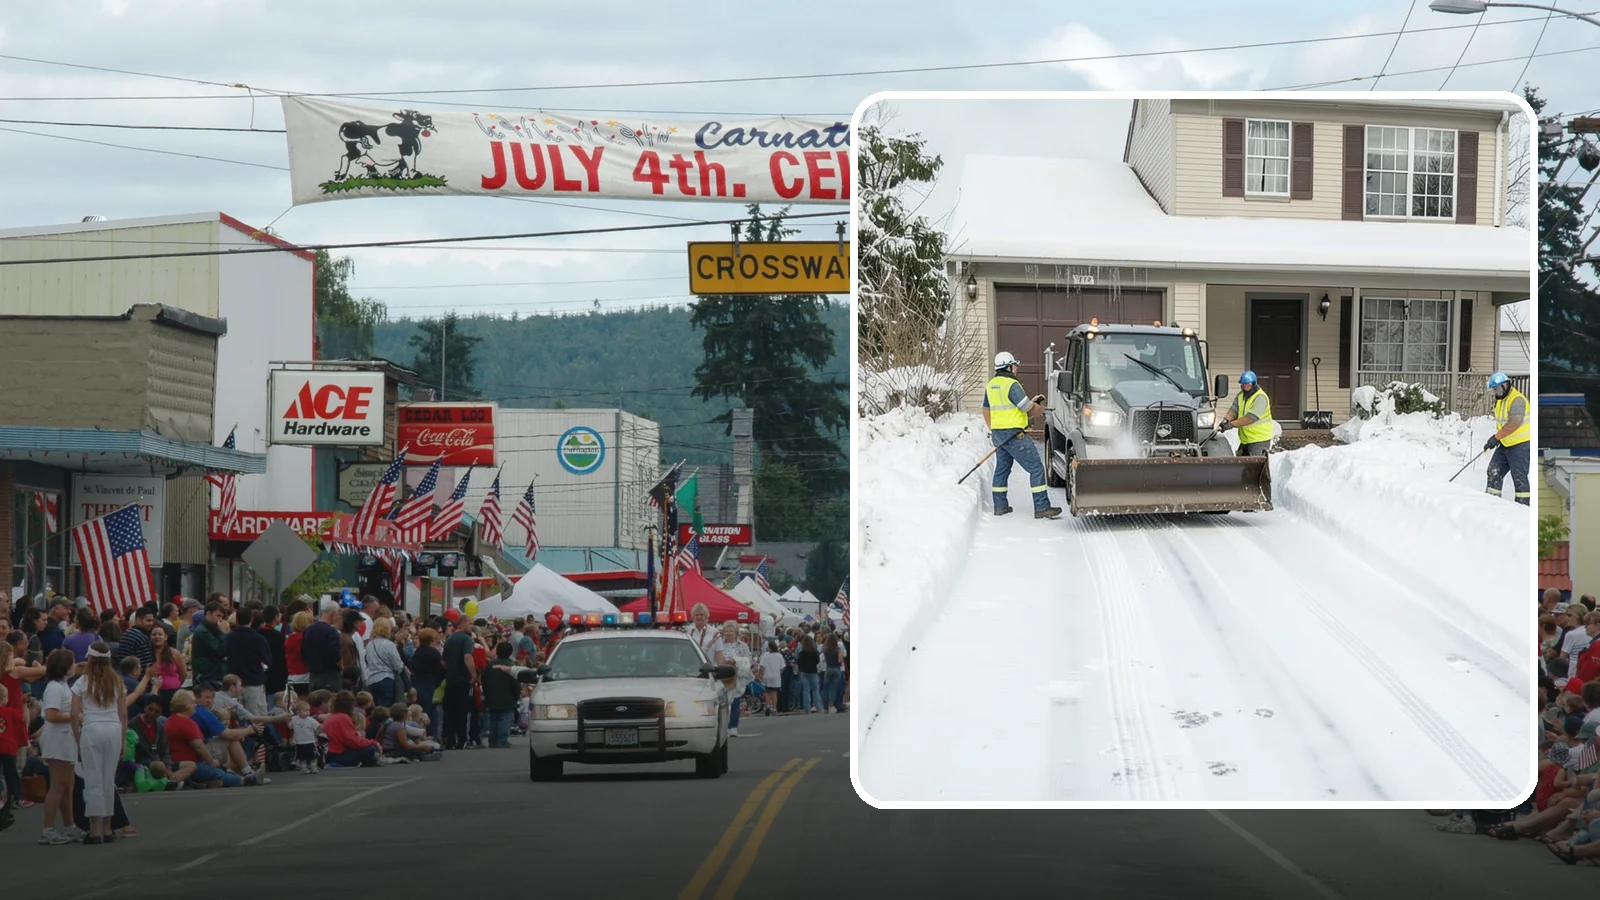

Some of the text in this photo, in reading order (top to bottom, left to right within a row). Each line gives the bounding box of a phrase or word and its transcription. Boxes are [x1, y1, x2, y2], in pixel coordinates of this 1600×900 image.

[481, 141, 605, 193] JULY
[632, 150, 746, 197] 4th.
[697, 254, 850, 280] CROSSWA
[283, 380, 373, 420] ACE
[406, 409, 452, 421] CEDAR
[283, 421, 371, 436] Hardware
[416, 428, 477, 446] Coca-Cola
[83, 485, 155, 495] St. Vincent de Paul
[688, 527, 741, 535] CRNATION
[699, 535, 731, 543] GLASS
